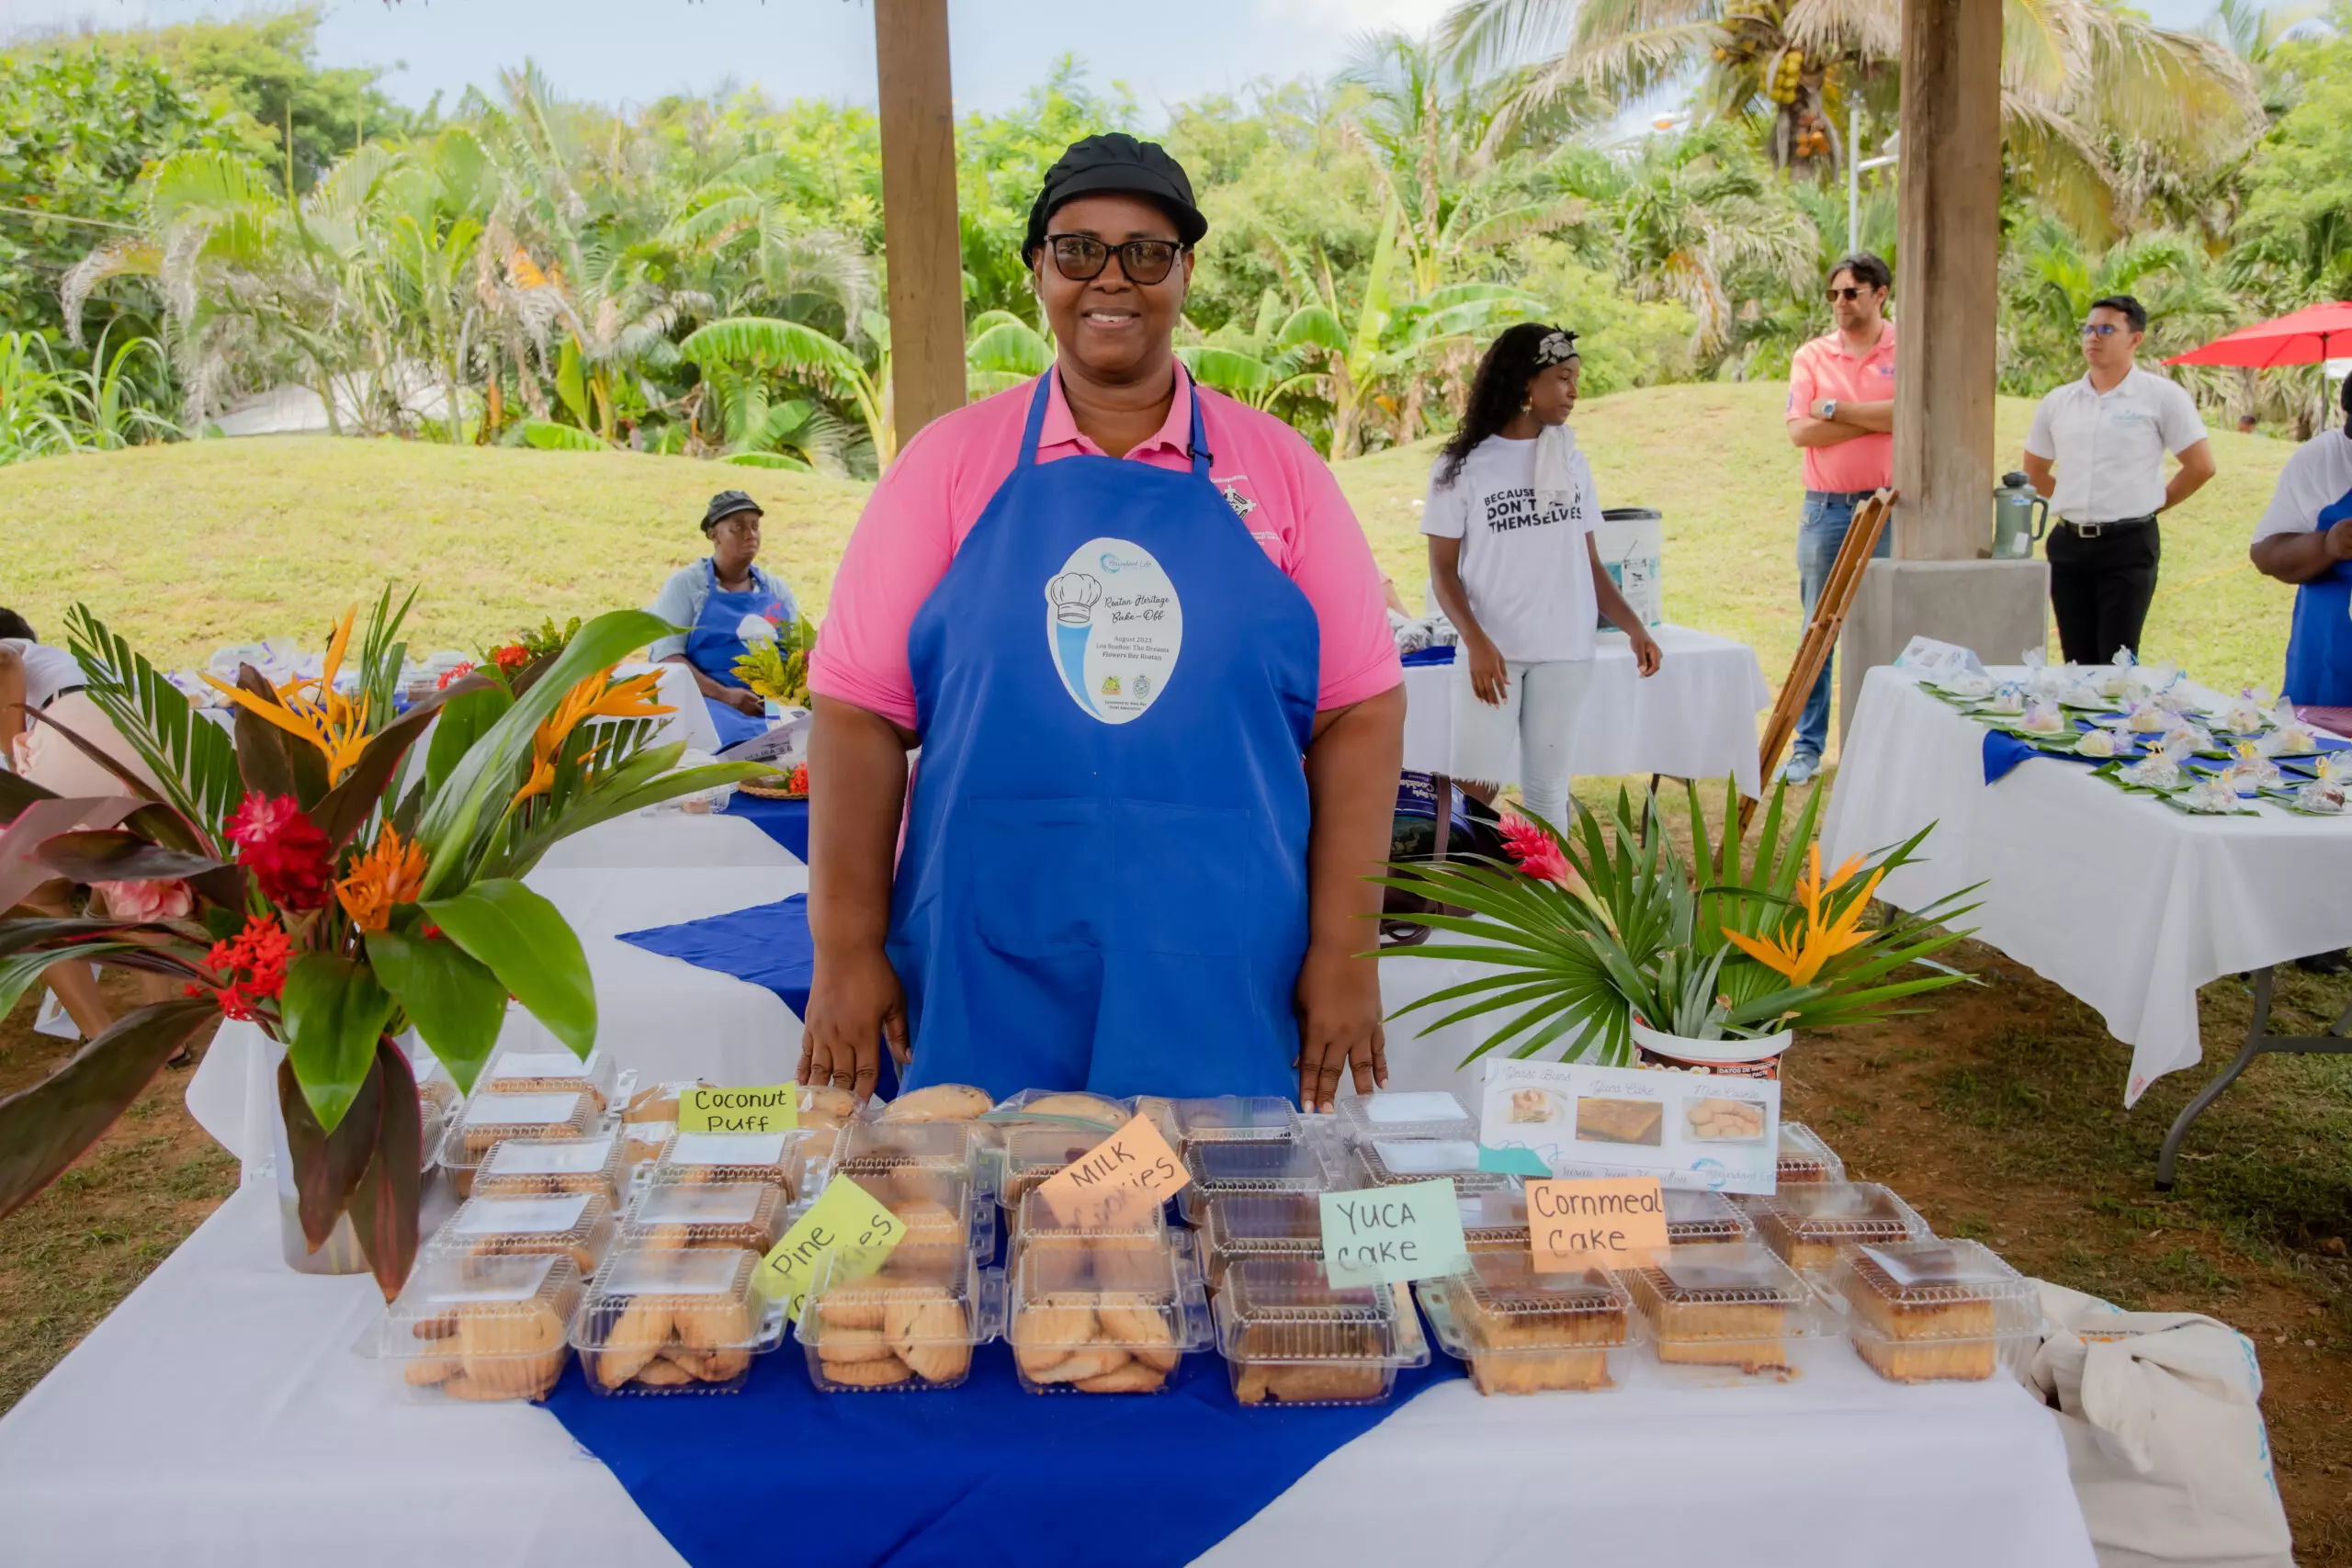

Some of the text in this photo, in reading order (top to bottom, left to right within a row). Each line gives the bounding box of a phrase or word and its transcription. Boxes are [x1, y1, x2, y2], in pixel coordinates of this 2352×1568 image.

[1484, 489, 1534, 506] BECAUSE
[1487, 499, 1536, 521] DON'T
[1488, 507, 1582, 535] THEMSELVES
[1104, 594, 1170, 608] Roatan Heritage
[695, 1089, 787, 1111] Coconut
[1069, 1141, 1136, 1188] MILK
[1534, 1188, 1663, 1218] Cornmeal
[1337, 1201, 1416, 1235] YUCA
